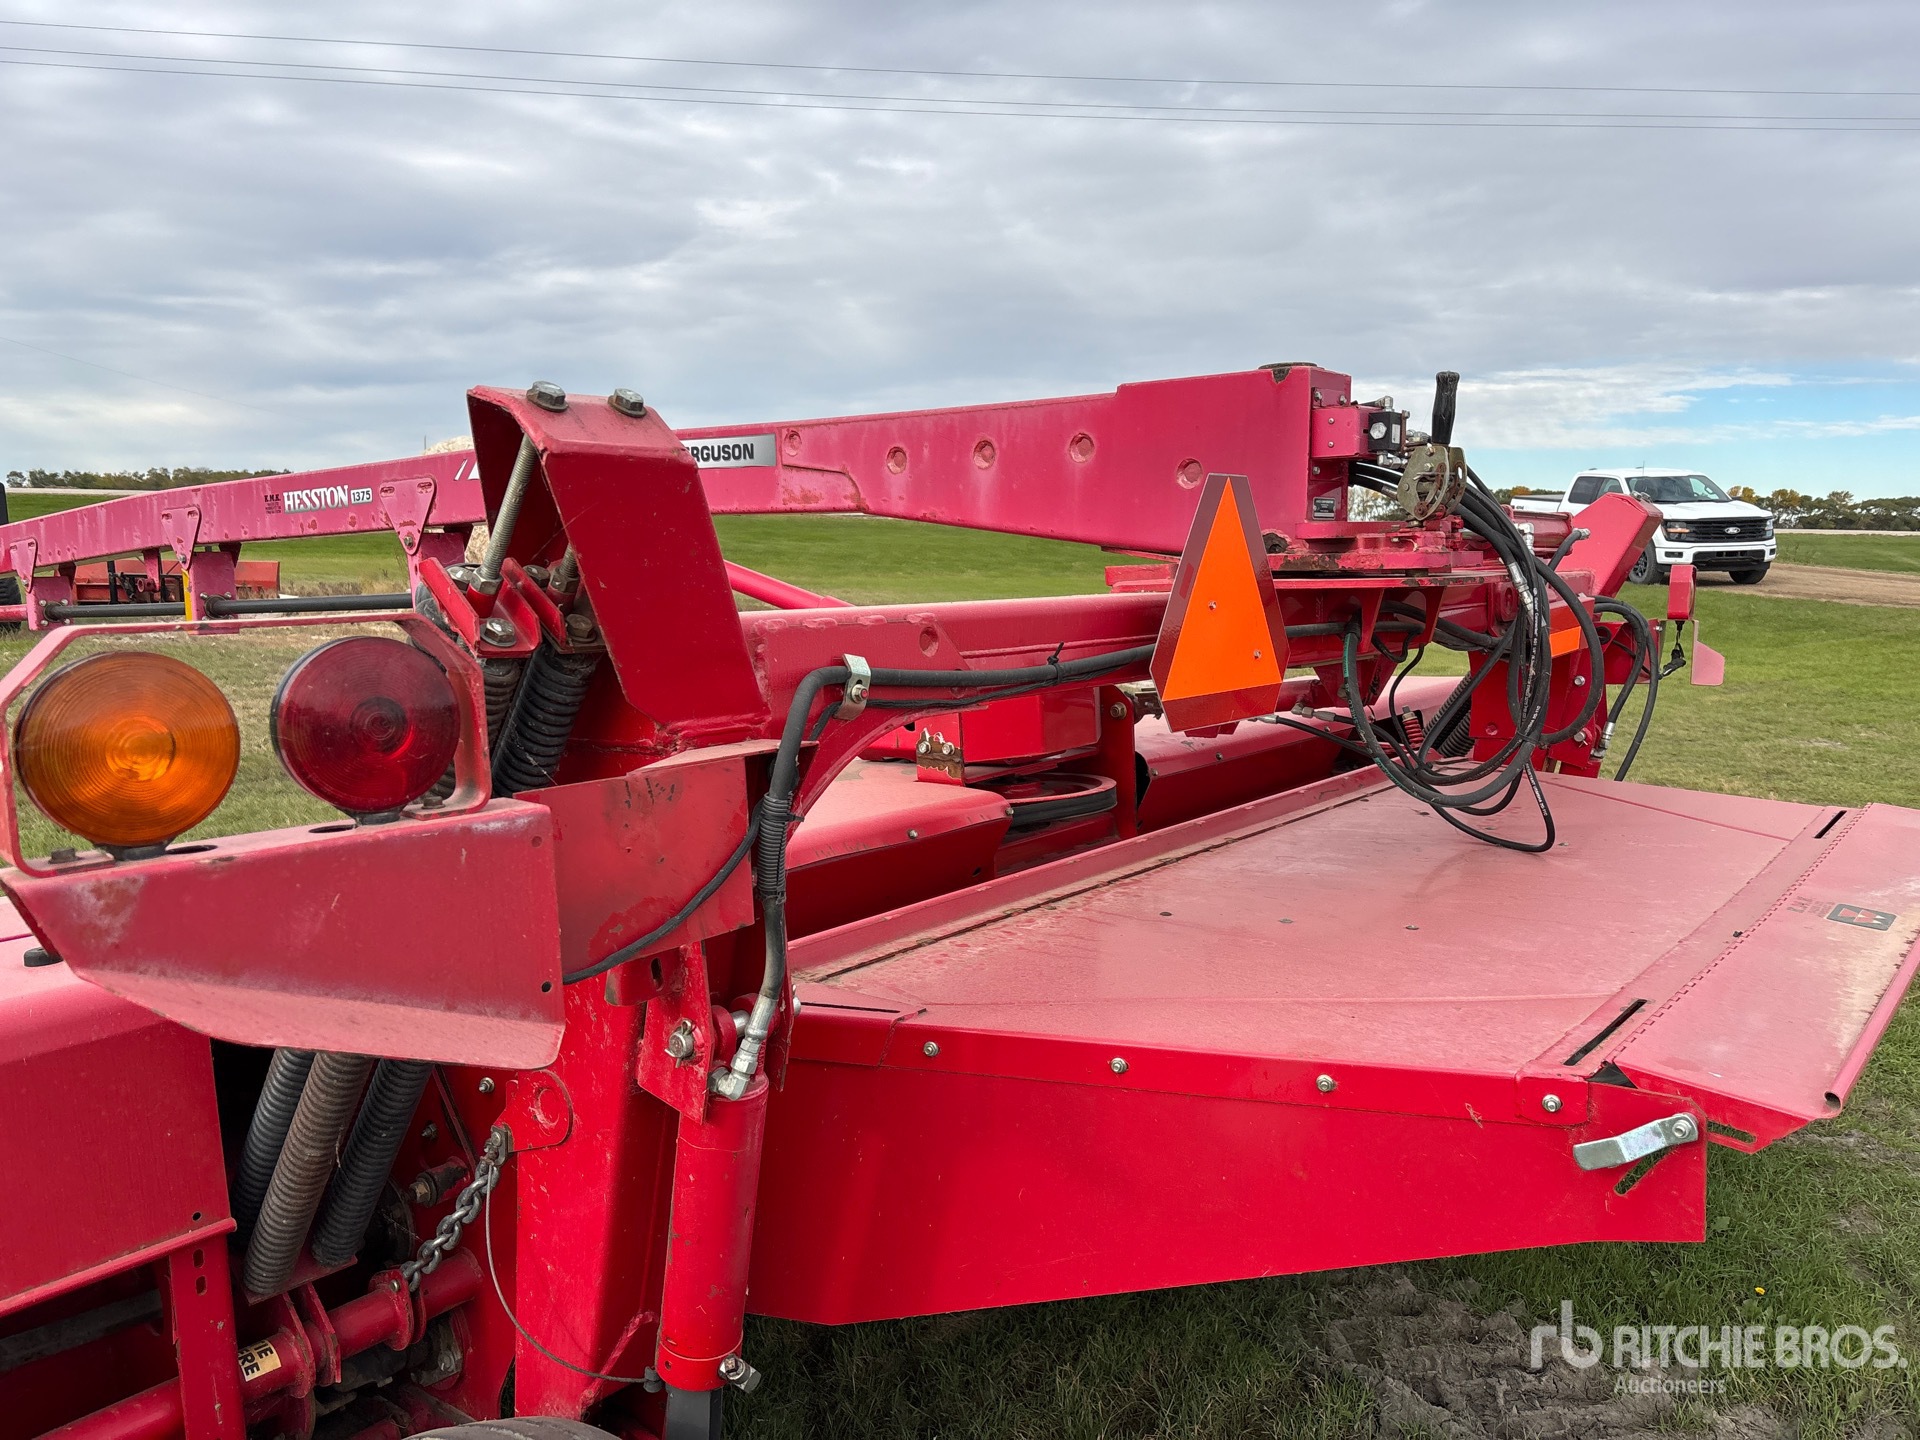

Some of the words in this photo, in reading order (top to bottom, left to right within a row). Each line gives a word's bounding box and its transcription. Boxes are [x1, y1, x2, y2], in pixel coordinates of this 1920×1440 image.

[685, 443, 754, 462] RGUSON
[283, 485, 349, 513] HESSTON
[352, 490, 371, 502] 1375
